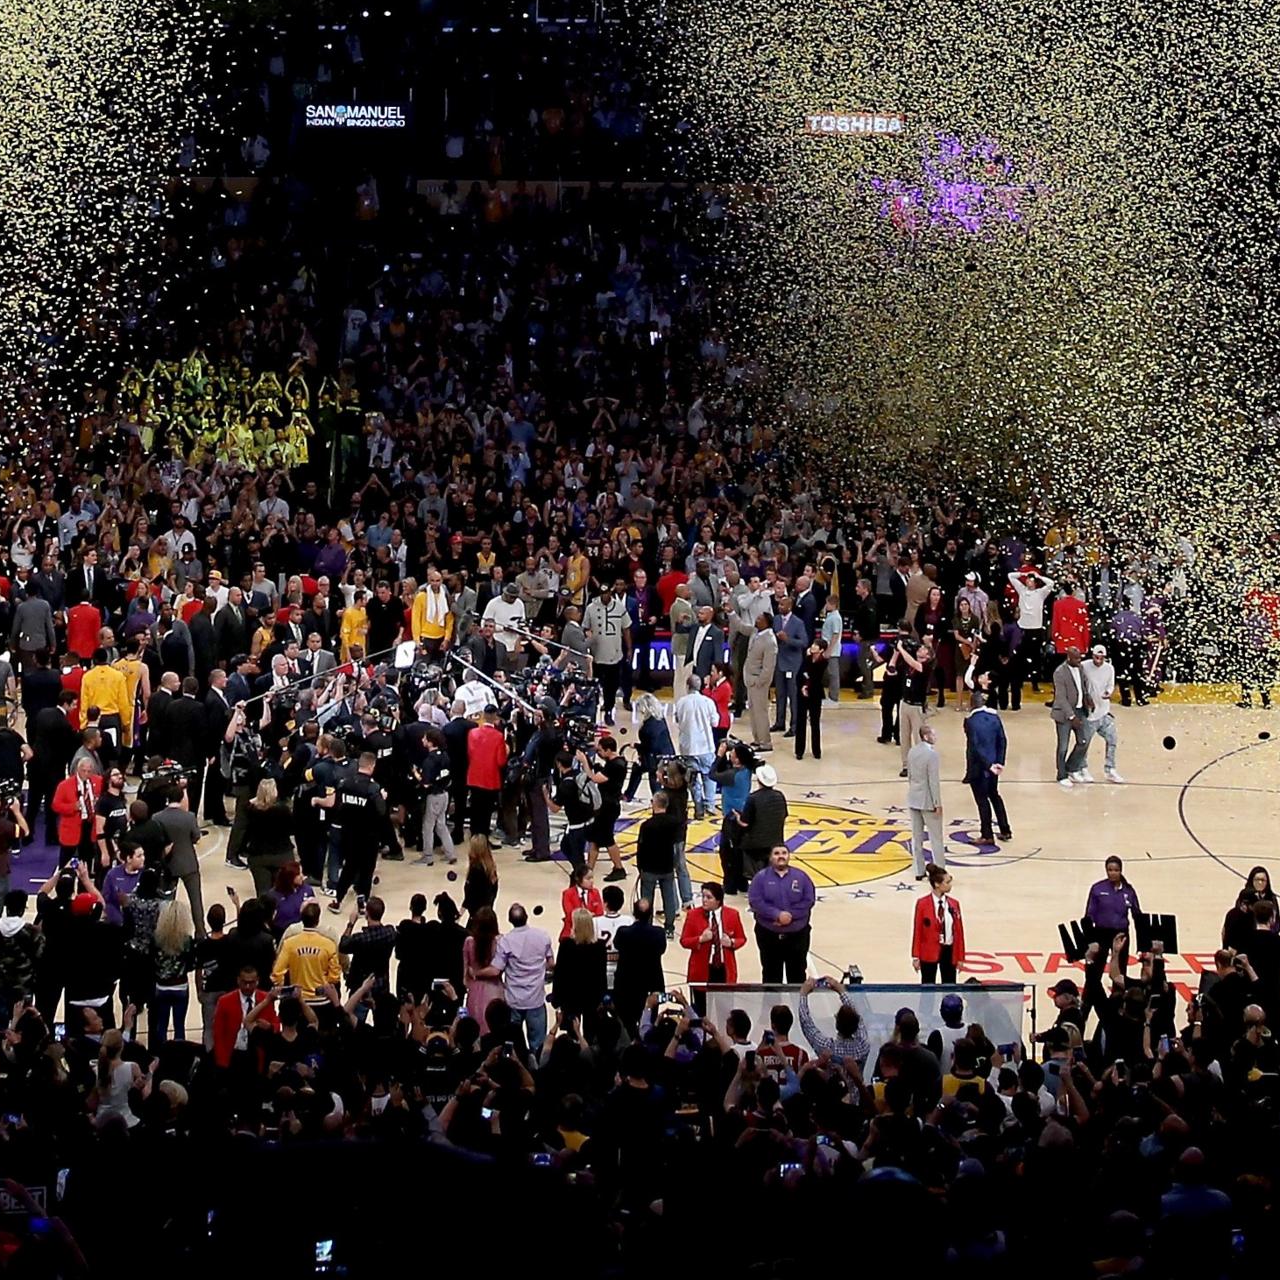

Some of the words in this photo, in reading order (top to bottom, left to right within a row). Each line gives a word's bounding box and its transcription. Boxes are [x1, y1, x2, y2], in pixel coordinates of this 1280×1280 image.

[306, 105, 335, 118] SAN
[346, 105, 405, 119] MANUEL
[807, 115, 901, 132] TOSHIBA
